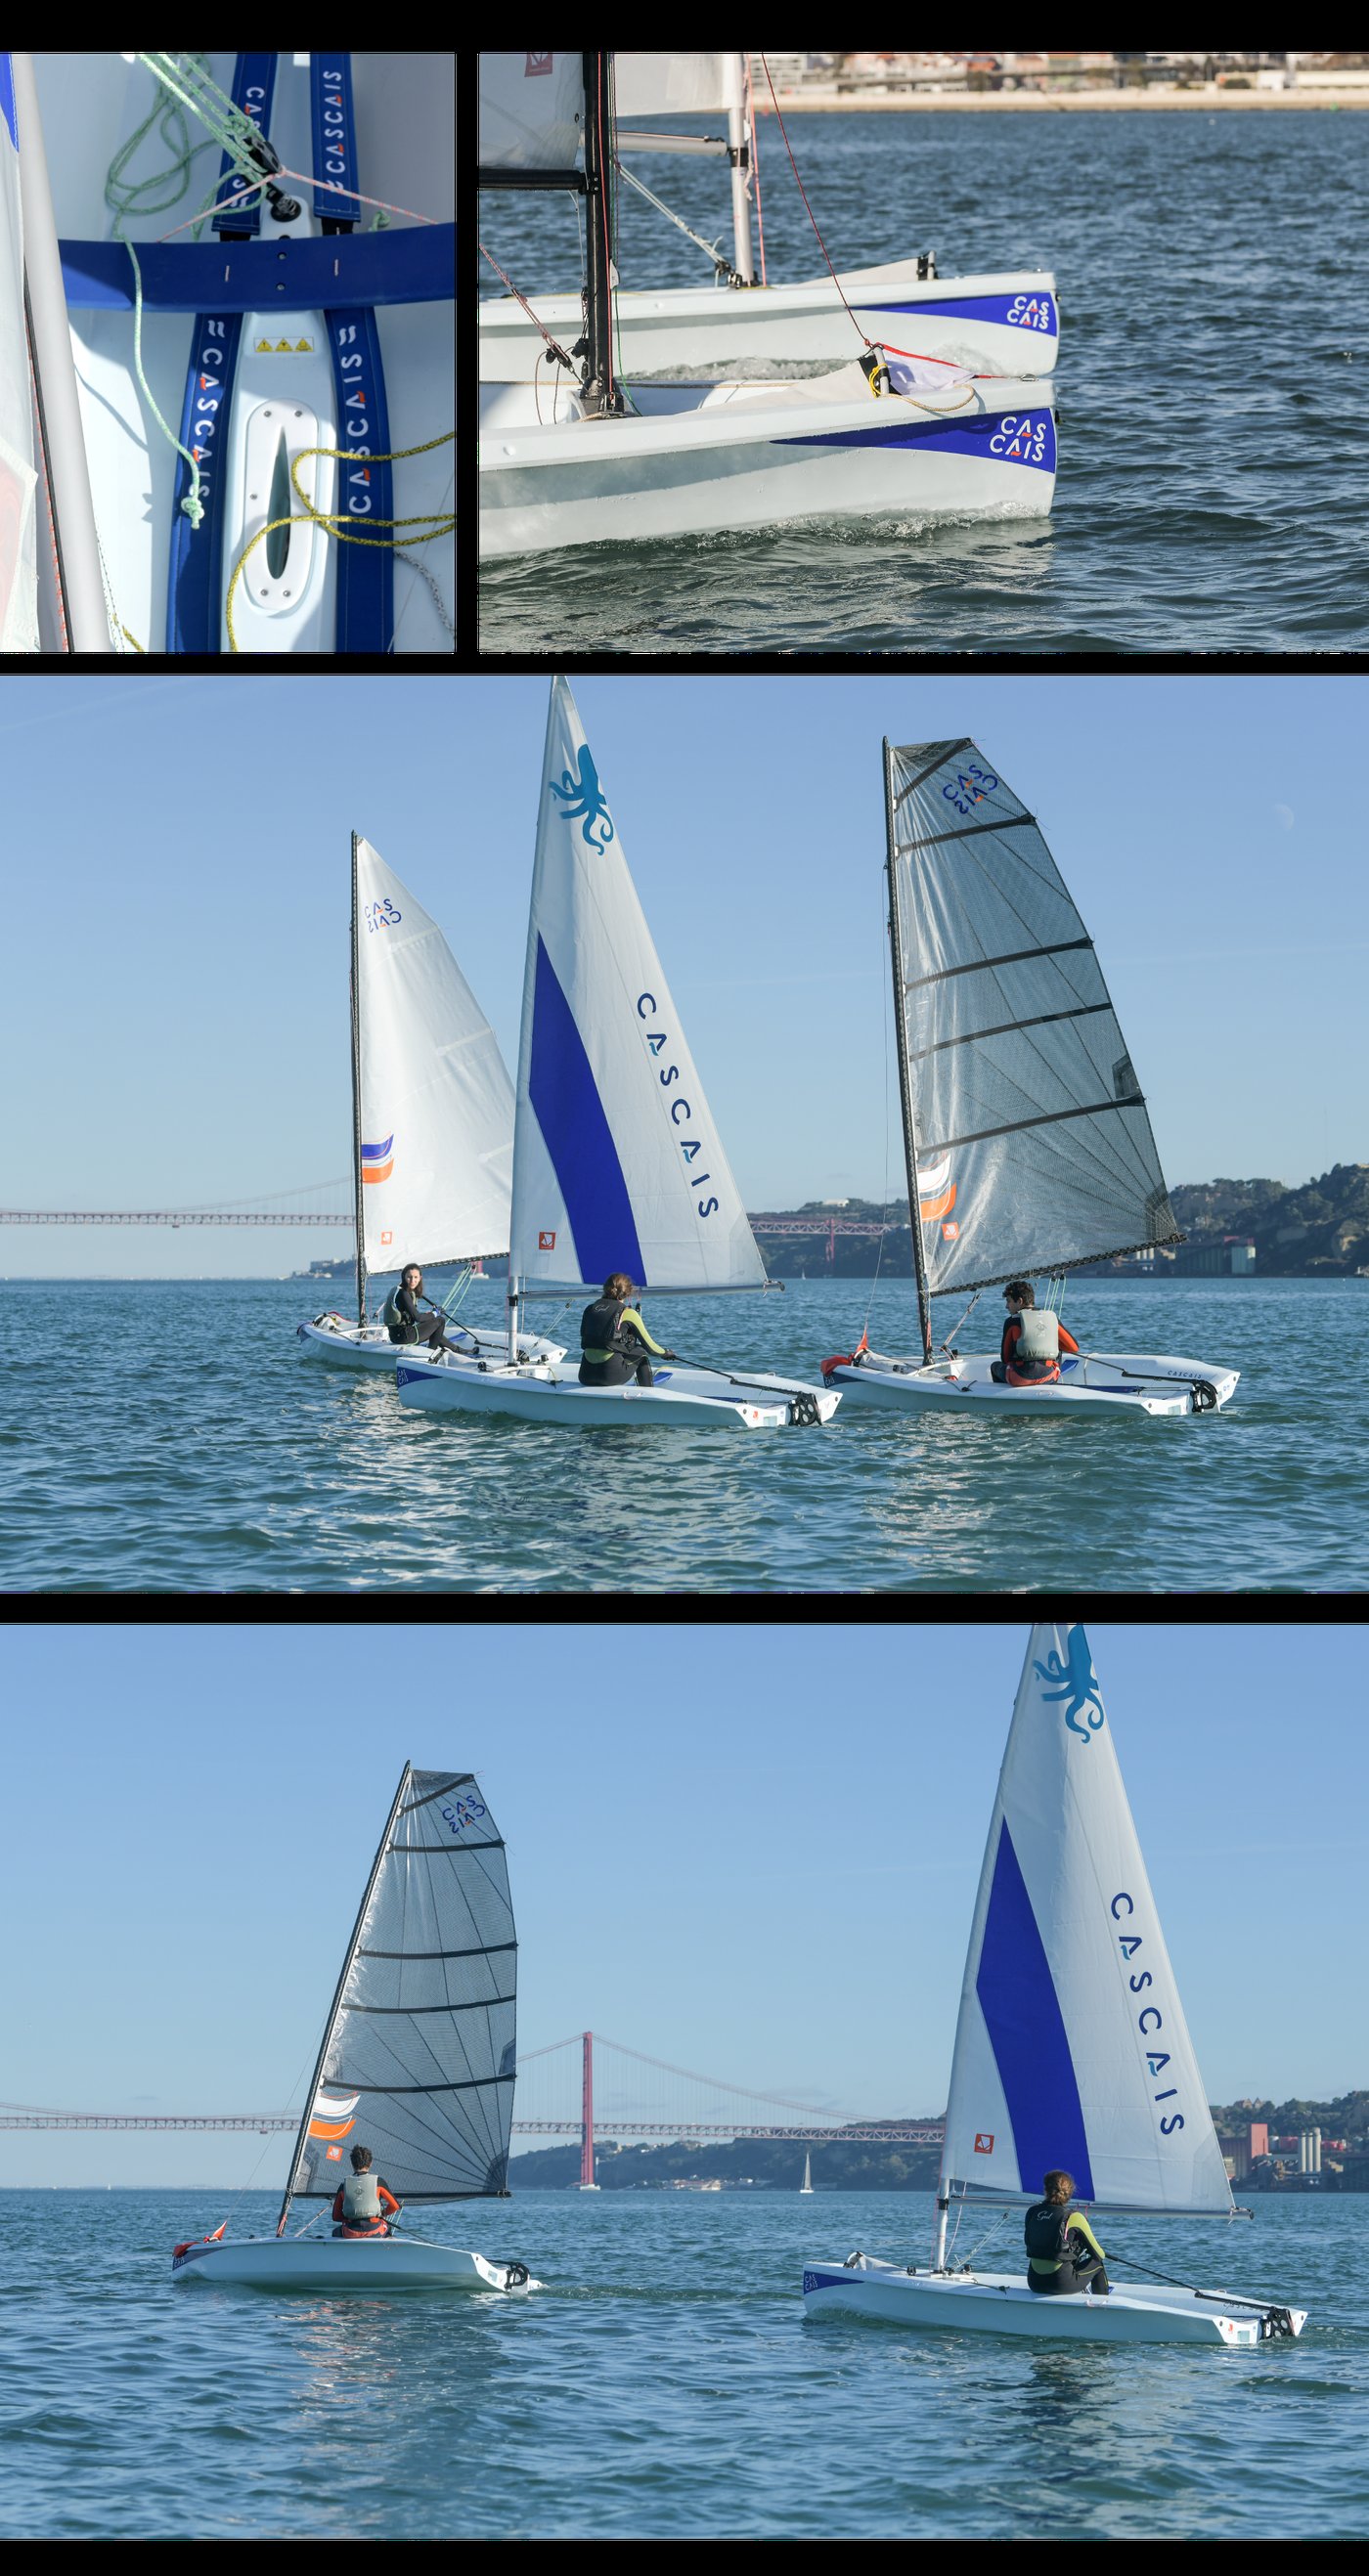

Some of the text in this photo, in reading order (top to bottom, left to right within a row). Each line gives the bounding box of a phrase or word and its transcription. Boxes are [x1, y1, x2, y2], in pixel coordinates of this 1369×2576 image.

[323, 70, 345, 174] CASCAIS
[1006, 309, 1049, 329] CAIS
[1014, 296, 1049, 316] CAS
[189, 347, 223, 498] CASCAIS
[341, 353, 373, 514] CASCAIS
[1000, 415, 1046, 442] CAS
[990, 434, 1045, 461] CAIS
[942, 764, 984, 800] CAS
[365, 898, 393, 919] CAS
[637, 992, 719, 1218] CASCAIS
[1168, 1370, 1202, 1379] CASCAIS
[442, 1795, 476, 1820] CAS
[1111, 1892, 1185, 2135] CASCAIS
[805, 2274, 816, 2284] CAS
